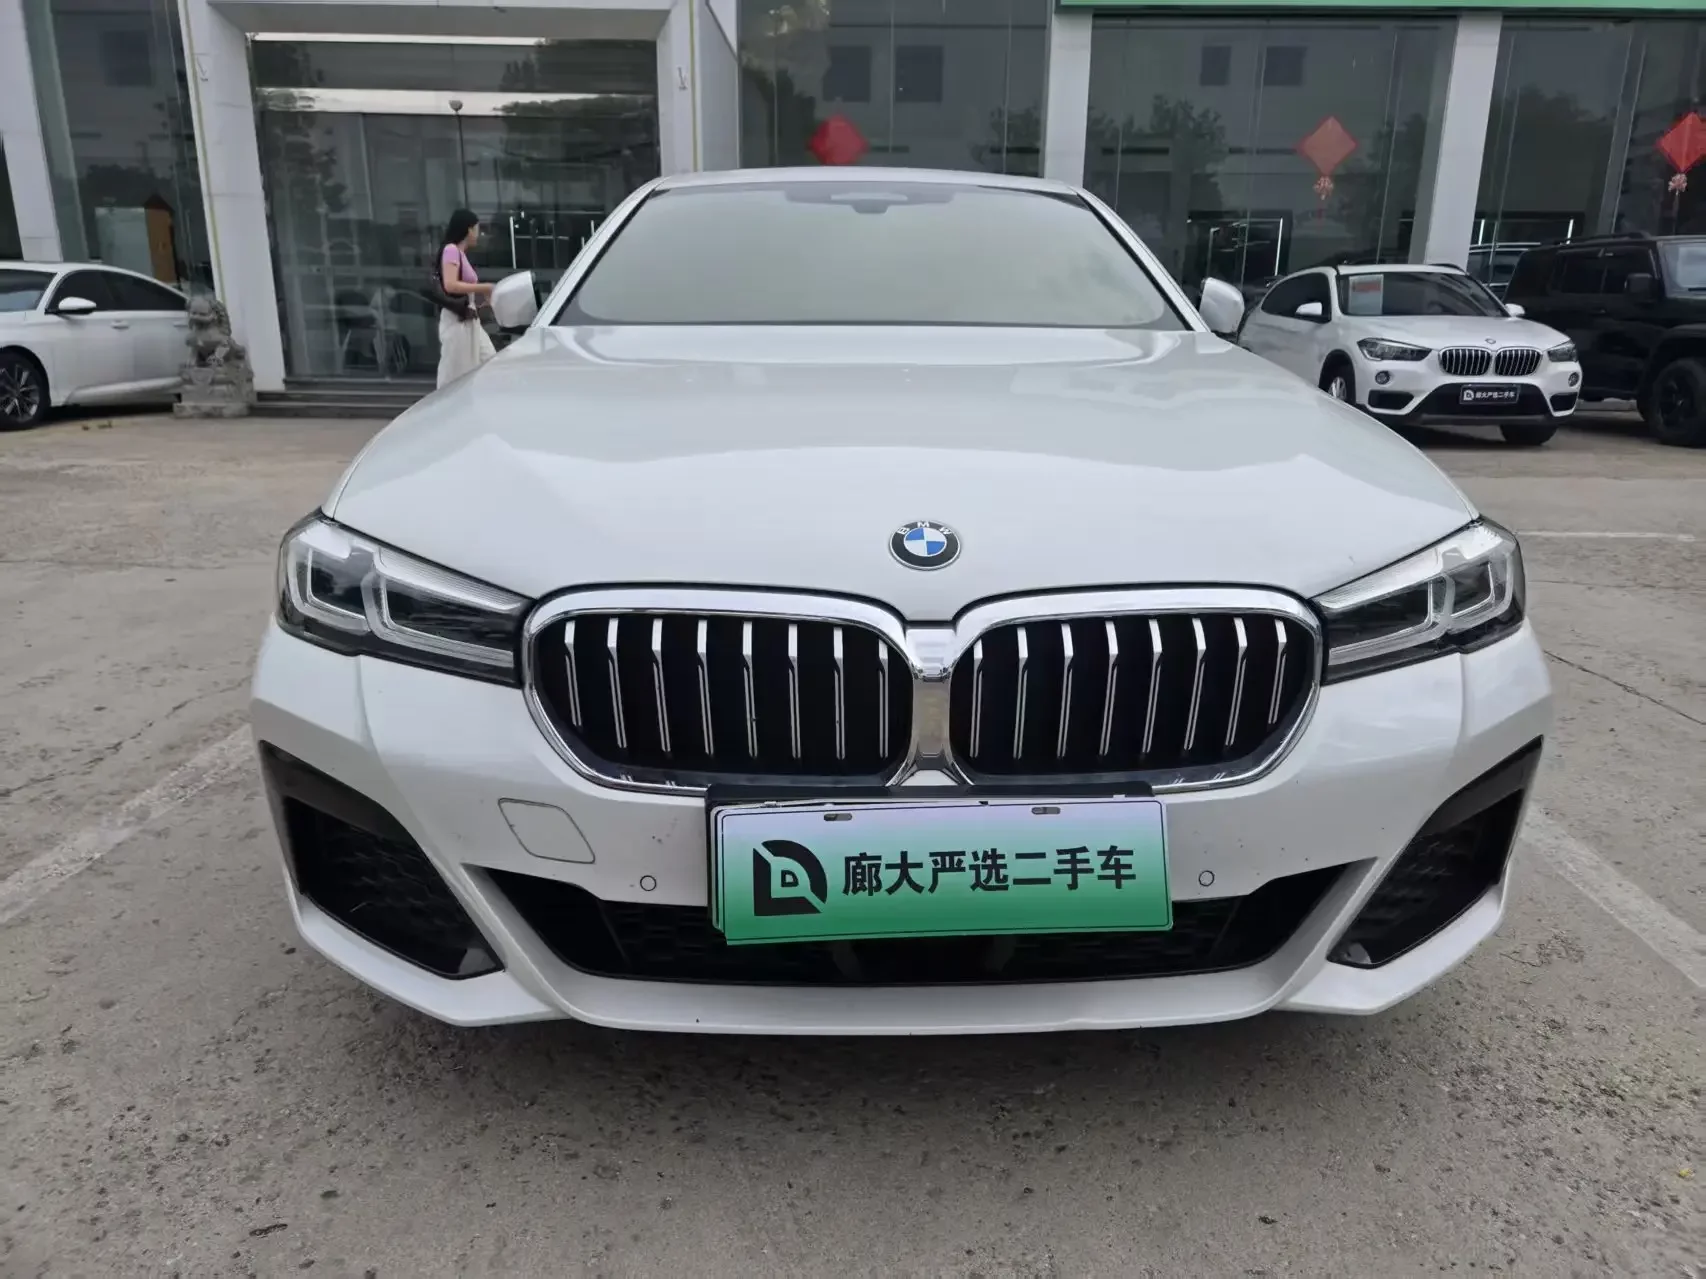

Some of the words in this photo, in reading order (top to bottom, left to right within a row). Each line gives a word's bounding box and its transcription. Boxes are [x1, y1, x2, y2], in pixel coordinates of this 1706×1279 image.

[897, 520, 952, 535] BMW
[842, 845, 1136, 897] 廊大严选二手车
